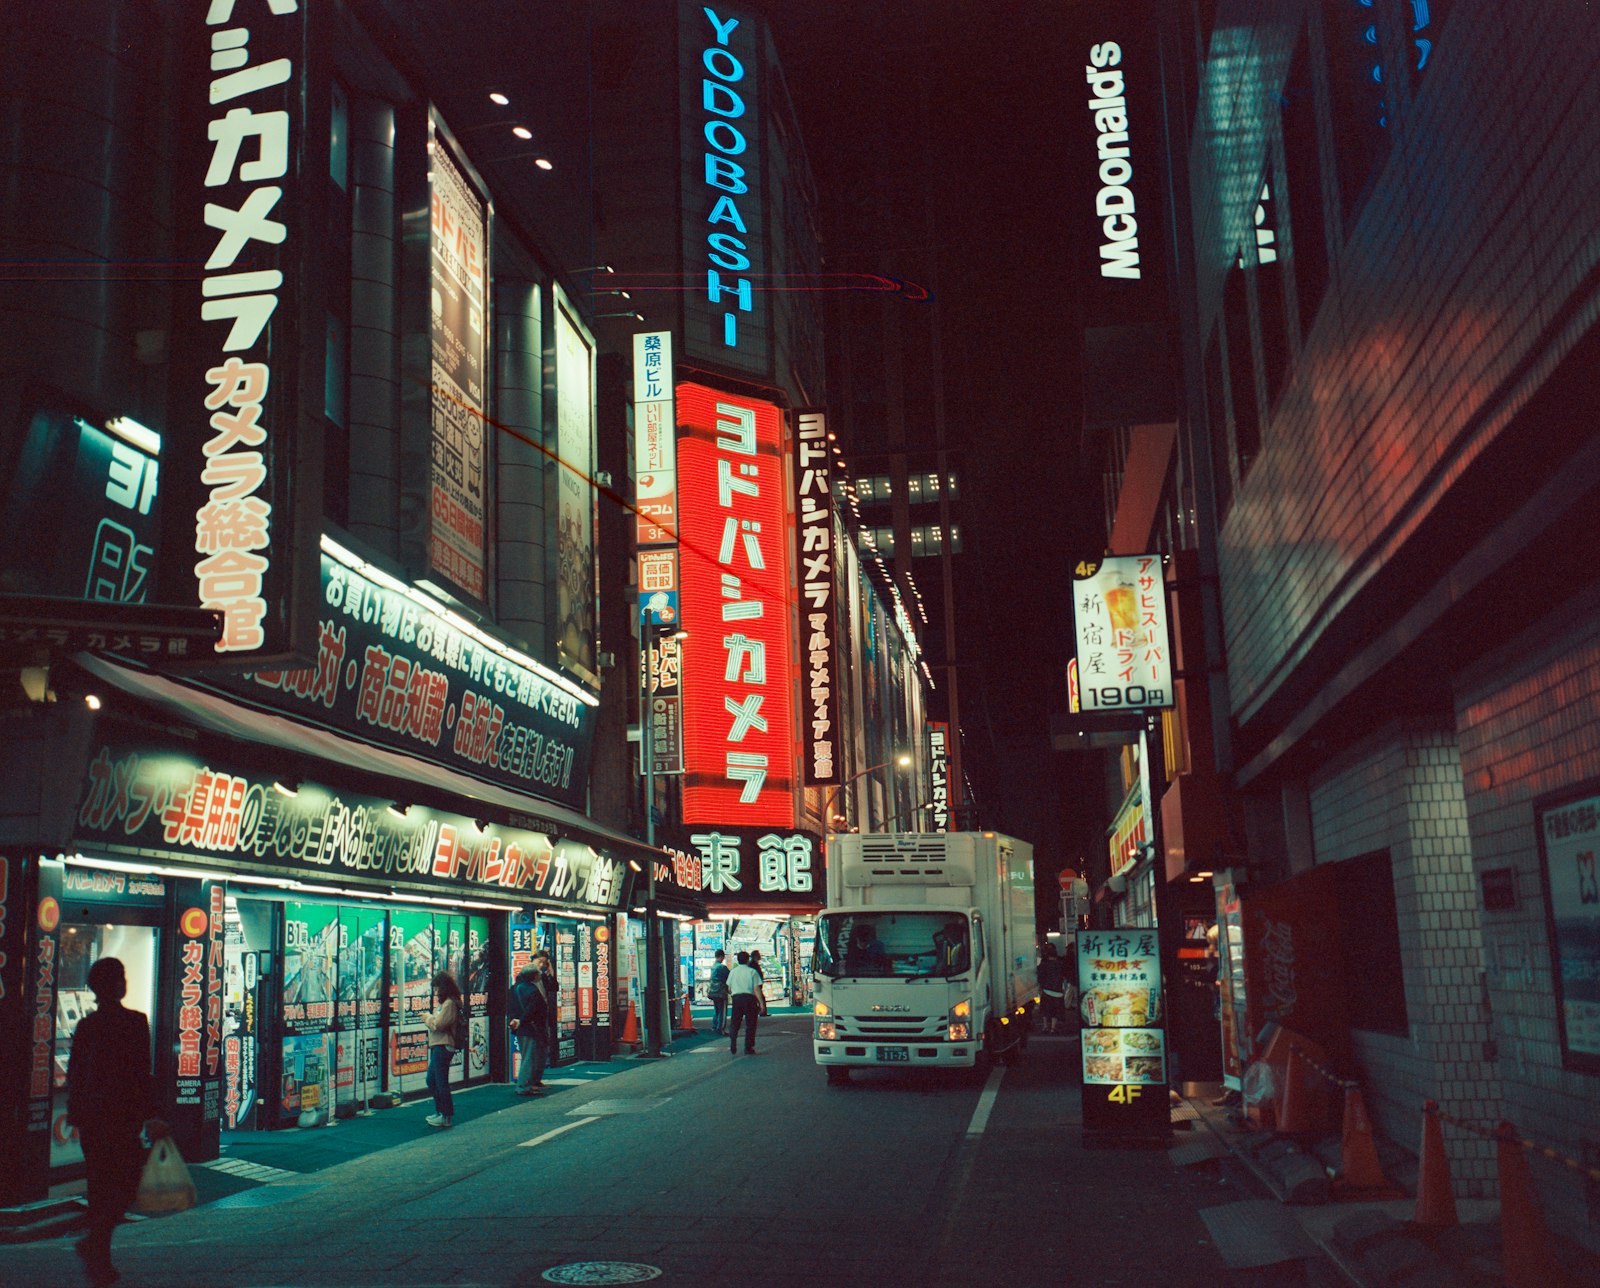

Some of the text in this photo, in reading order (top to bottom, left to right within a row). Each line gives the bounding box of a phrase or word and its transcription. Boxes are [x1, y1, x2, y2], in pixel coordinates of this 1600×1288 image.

[703, 7, 752, 346] YODOBASHI
[1086, 41, 1141, 280] McDonald's
[644, 335, 662, 398] 桑原ビル
[194, 356, 272, 652] カメラ総合館
[640, 505, 673, 516] アコム
[648, 528, 664, 540] 3F
[799, 412, 831, 608] ヨドバシカメラ
[646, 563, 670, 575] 高価
[646, 576, 670, 588] 買取
[716, 402, 768, 804] ヨドバシカメラ
[1075, 561, 1096, 576] 4F
[1080, 593, 1106, 675] 新宿屋
[1117, 631, 1136, 682] ドライ
[1137, 557, 1161, 681] アサヒスーパー
[808, 612, 833, 779] マルチメディア東館
[1089, 686, 1164, 707] 190円
[931, 732, 947, 827] ヨドバシカメラ
[432, 822, 552, 892] ヨドバシカメラ
[549, 848, 626, 906] カメラ総合館
[690, 832, 812, 893] 東館
[204, 885, 223, 1076] ヨドバシカメラ
[596, 942, 609, 1013] カメラ総合館
[1081, 935, 1156, 957] 新宿屋
[178, 941, 203, 1077] カメラ総合館
[871, 1004, 911, 1012] ISUZU
[224, 1036, 241, 1129] 効果フィルター
[1108, 1085, 1142, 1104] 4F
